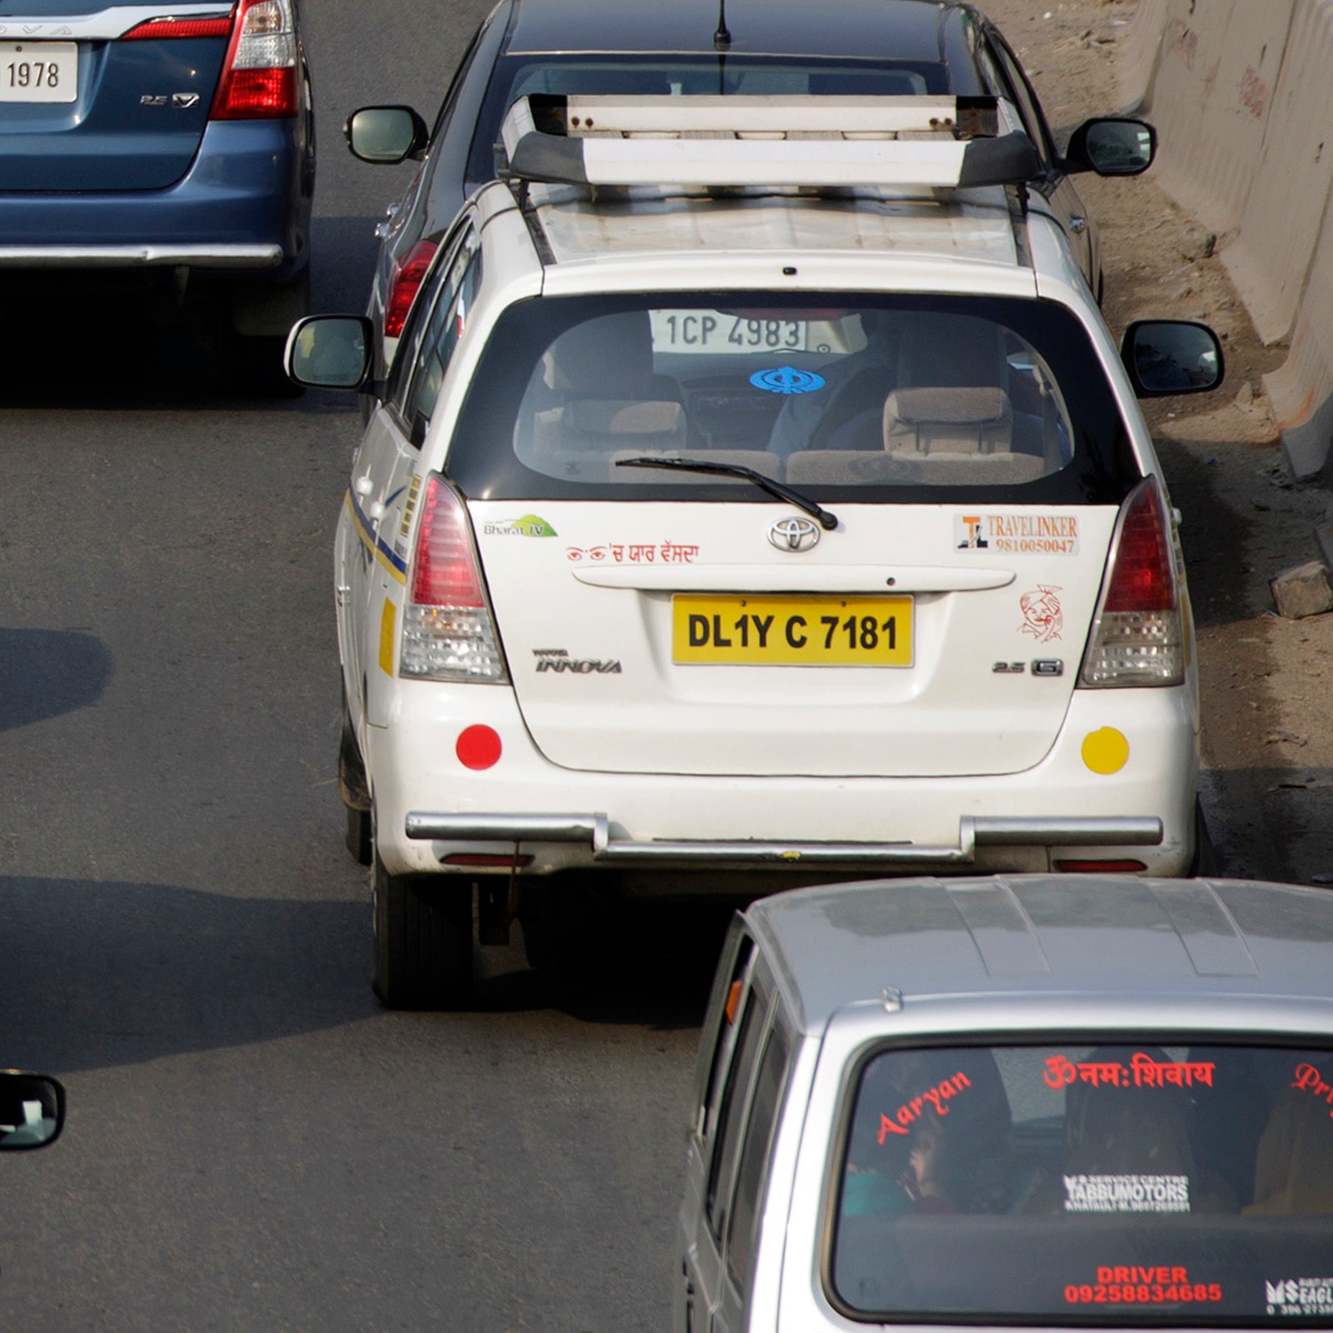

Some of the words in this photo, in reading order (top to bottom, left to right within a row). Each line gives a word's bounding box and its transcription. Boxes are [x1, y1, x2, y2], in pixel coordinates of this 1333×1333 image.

[6, 63, 60, 89] 1978
[667, 315, 717, 345] 1CP
[728, 316, 800, 348] 4983
[483, 523, 524, 536] Bharat
[528, 524, 545, 536] IV
[987, 514, 1078, 538] TRAVELINKER
[996, 538, 1075, 554] 9810050047
[688, 613, 775, 649] DL1Y
[785, 615, 808, 649] C
[821, 615, 897, 650] 7181
[535, 658, 623, 674] INNOVA
[876, 1070, 972, 1146] Aaryan
[1096, 1266, 1188, 1284] DRIVER
[1064, 1283, 1222, 1304] 09258834685
[1299, 1287, 1333, 1304] EAGL
